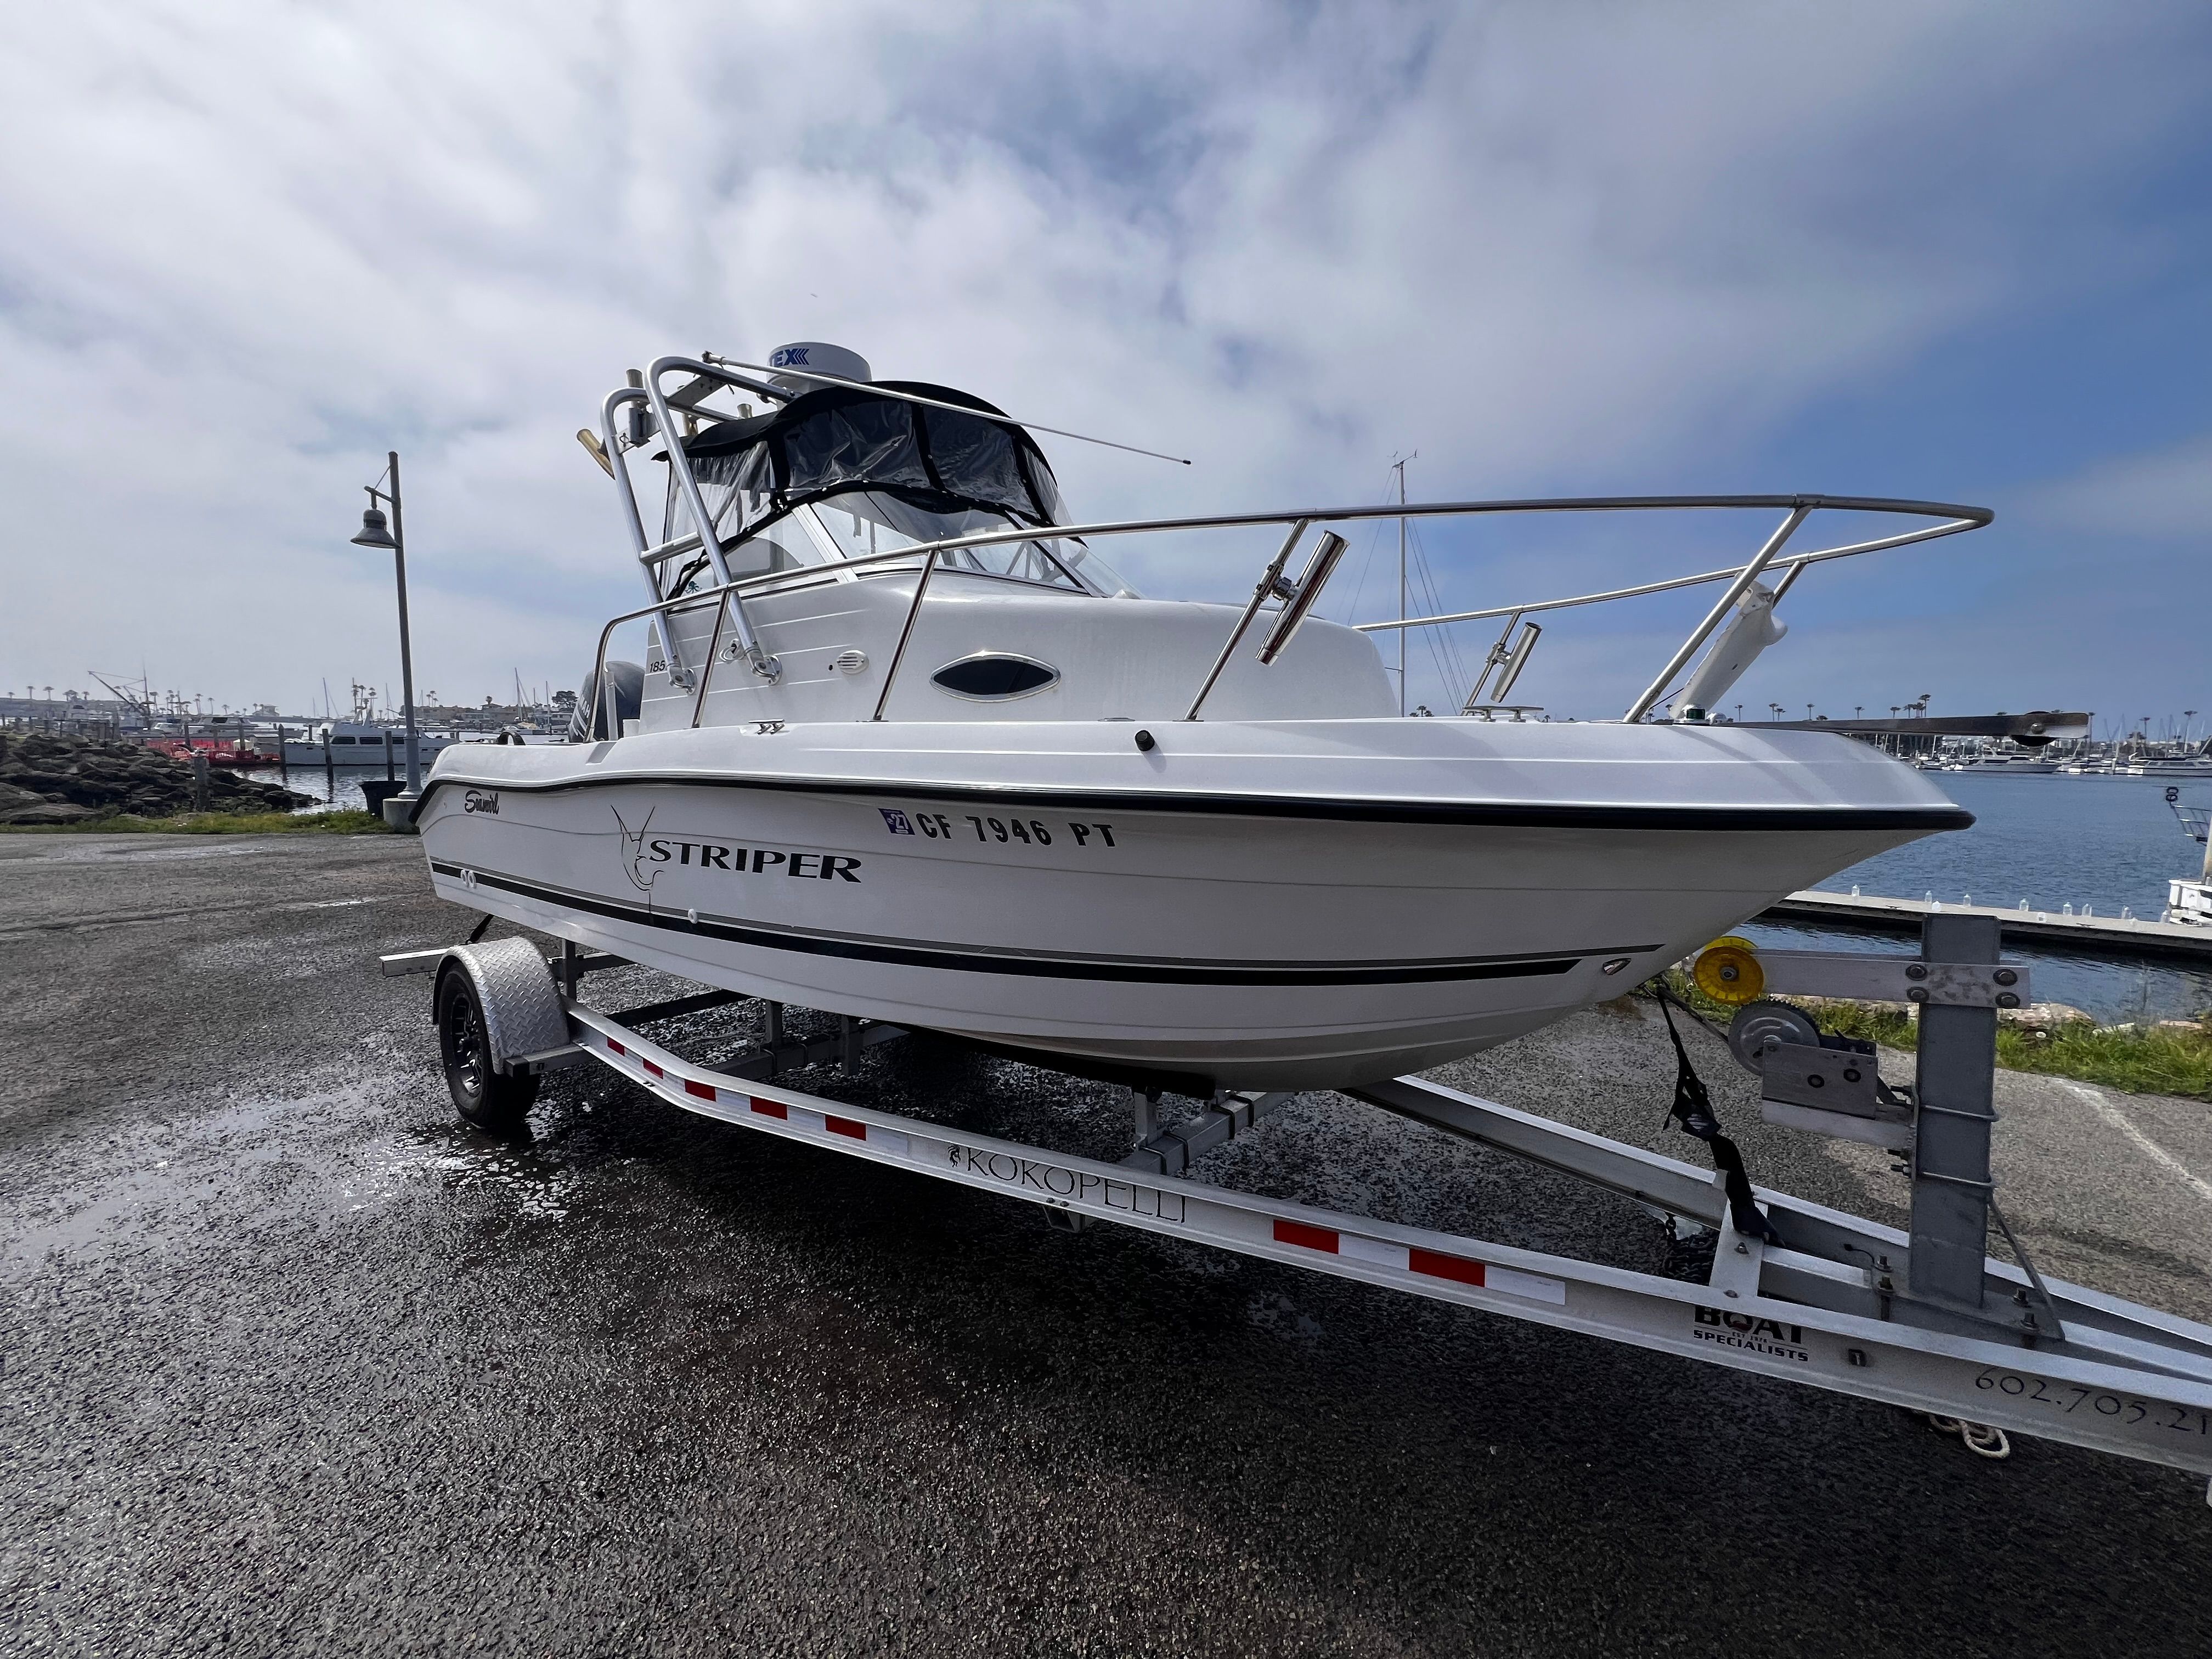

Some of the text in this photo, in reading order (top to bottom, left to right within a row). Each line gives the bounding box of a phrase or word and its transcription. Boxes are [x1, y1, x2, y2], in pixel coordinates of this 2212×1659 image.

[916, 813, 1115, 848] CF 7946 PT
[649, 839, 862, 883] STRIPER
[967, 1147, 1186, 1223] KOKOPELLI
[1693, 1329, 1809, 1362] SPECIALISTS
